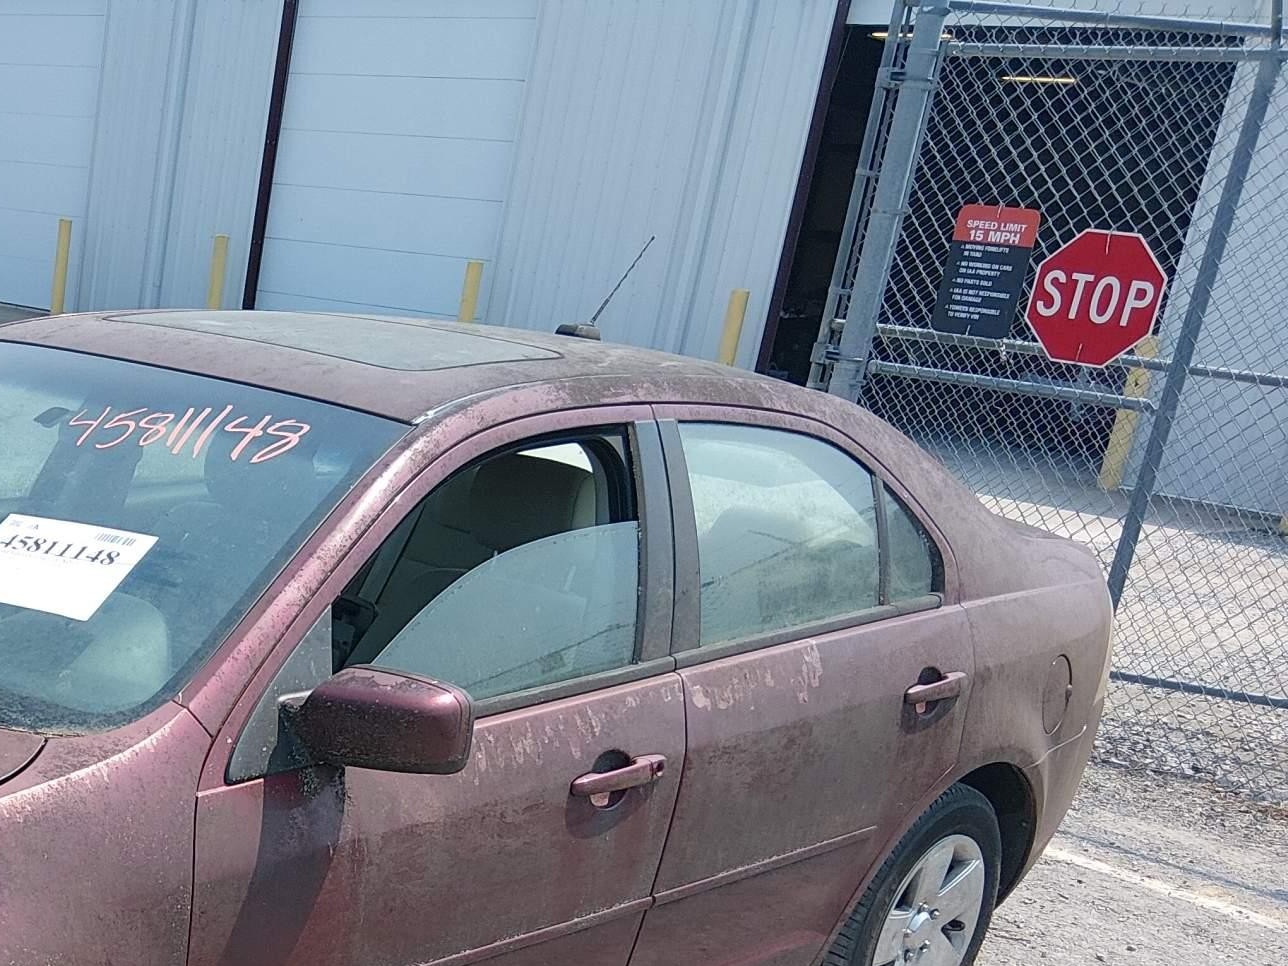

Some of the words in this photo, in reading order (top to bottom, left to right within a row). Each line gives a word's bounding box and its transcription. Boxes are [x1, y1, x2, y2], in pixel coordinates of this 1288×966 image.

[966, 219, 998, 231] SPEED
[999, 222, 1028, 233] LIMIT
[969, 229, 984, 241] 15
[987, 230, 1021, 244] MPH
[975, 269, 1001, 277] PROPERTY
[1036, 269, 1155, 327] STOP
[68, 404, 311, 464] 45811148
[0, 534, 121, 566] 45811148
